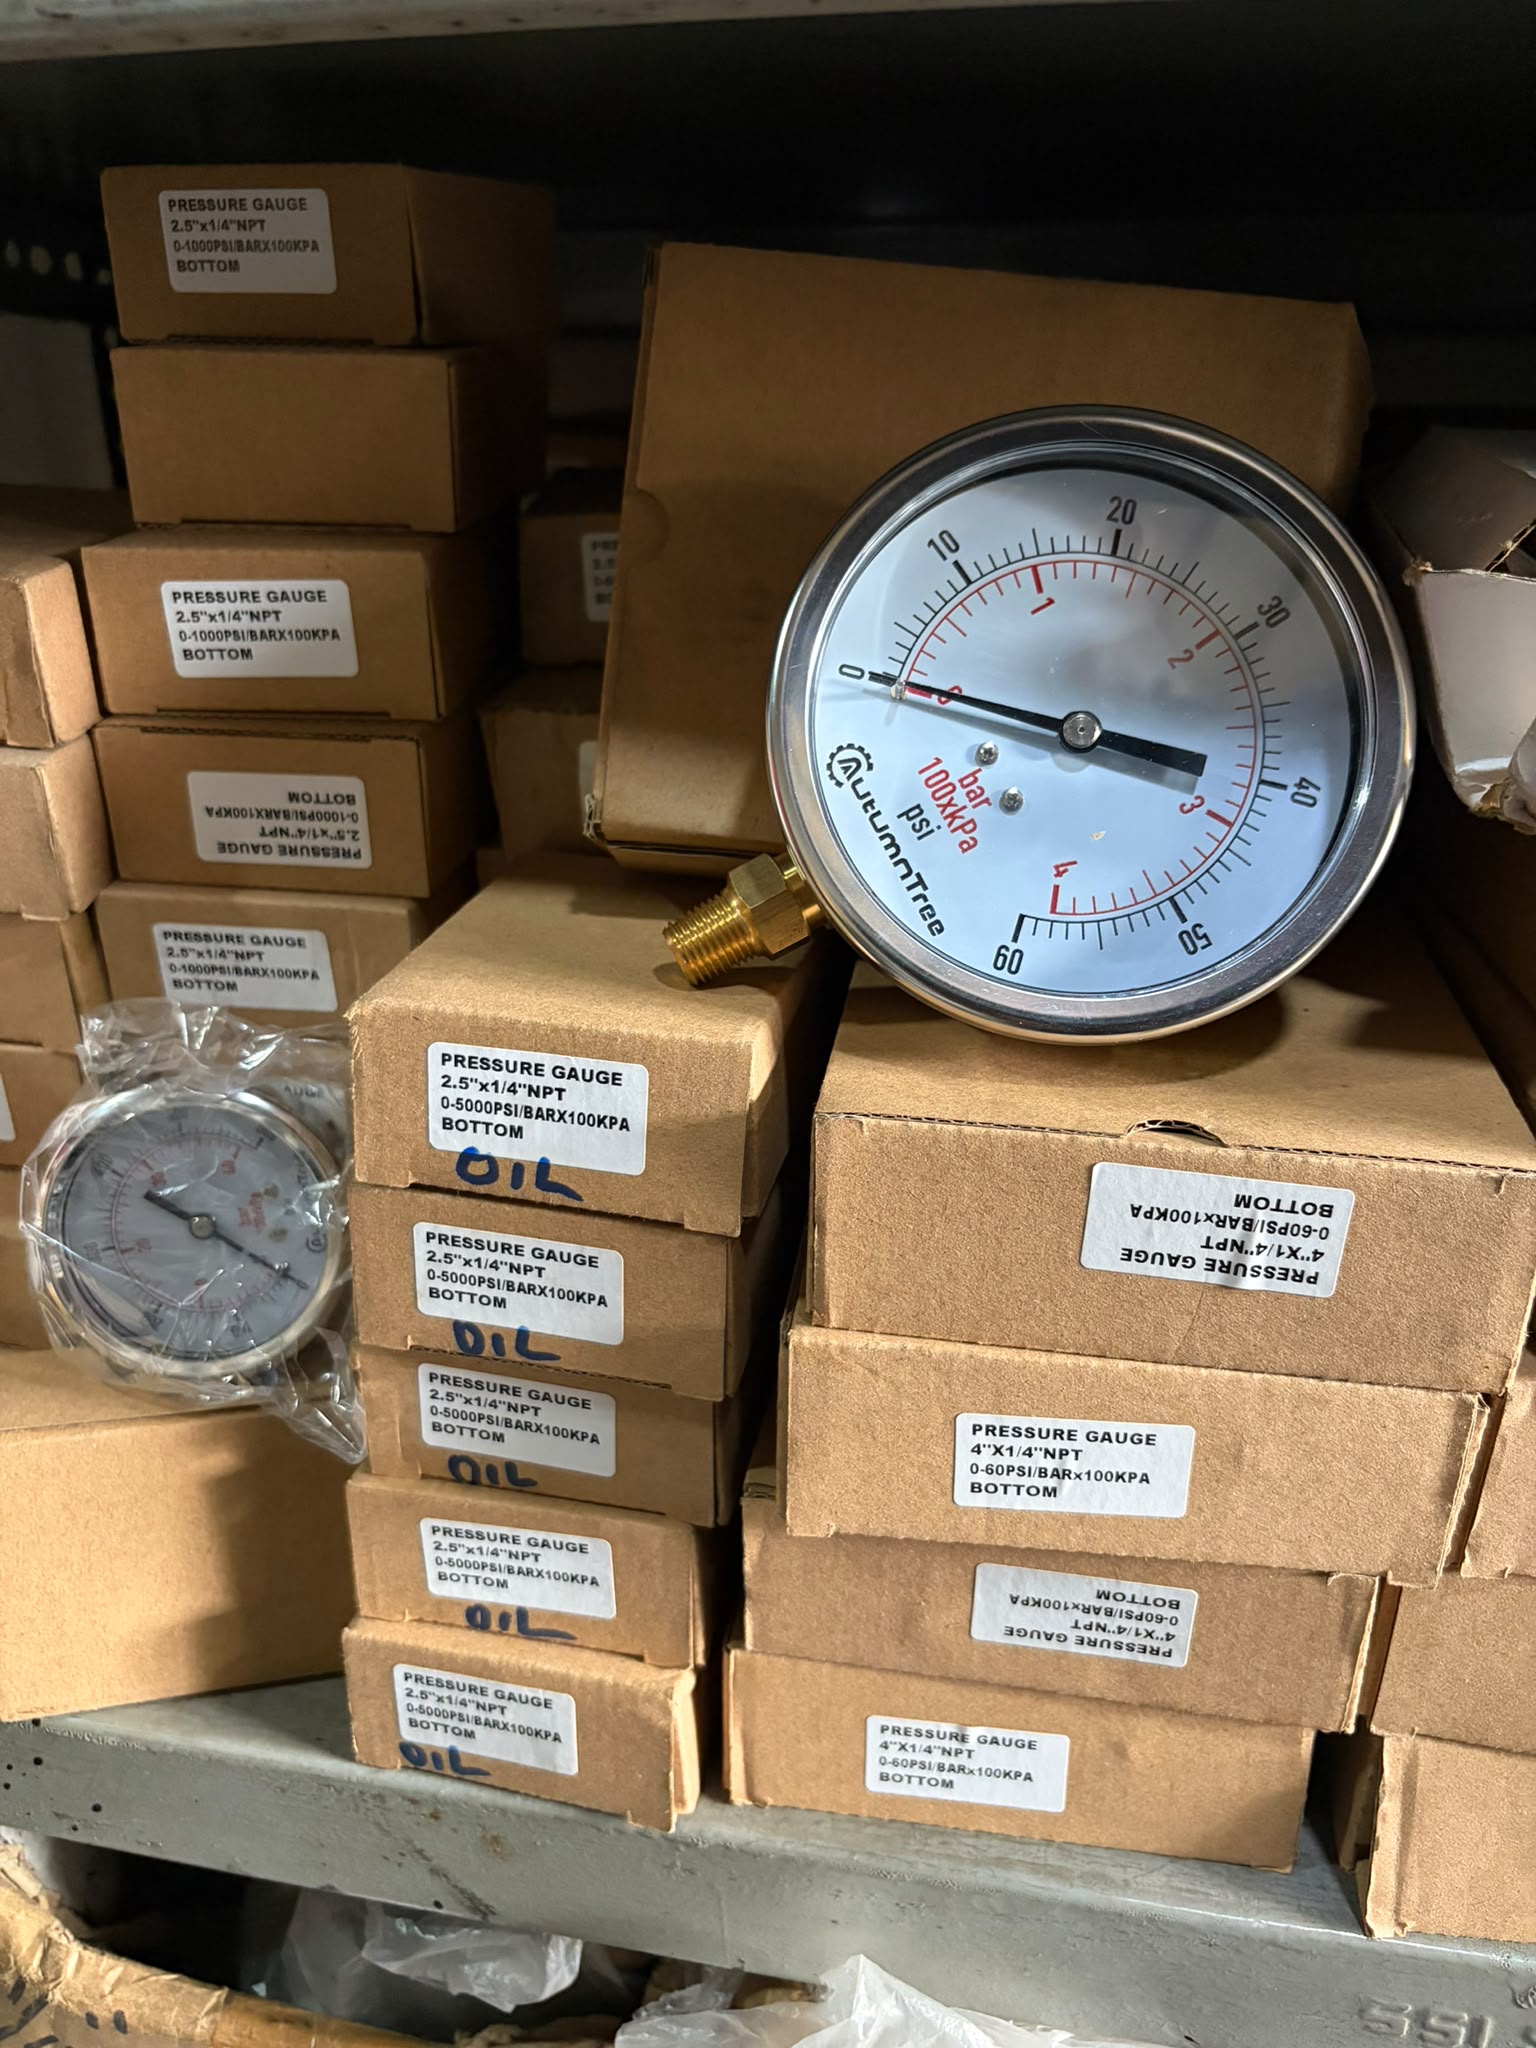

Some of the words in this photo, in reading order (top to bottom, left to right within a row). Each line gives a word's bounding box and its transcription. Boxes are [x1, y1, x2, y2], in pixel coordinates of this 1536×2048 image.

[168, 198, 248, 212] PRESSURE
[252, 197, 307, 211] GAUGE
[171, 219, 266, 232] 2.5"x1/4"NPT
[176, 260, 240, 272] BOTTOM
[1106, 495, 1137, 525] 20
[927, 528, 961, 561] 10
[172, 590, 261, 604] PRESSURE
[267, 590, 327, 603] GAUGE
[1031, 596, 1055, 616] 1
[176, 610, 282, 623] 2.5"x1/4"NPT
[1256, 595, 1292, 630] 30
[179, 629, 341, 642] 0-1000PSI/BARX100KPA
[183, 648, 253, 661] BOTTOM
[1167, 649, 1195, 670] 2
[838, 663, 865, 681] 0
[288, 791, 356, 805] BOTTOM
[957, 767, 993, 810] bar
[1290, 776, 1322, 809] 40
[917, 757, 979, 854] 100xkPa
[1179, 795, 1205, 815] 3
[896, 803, 942, 841] psi
[217, 841, 272, 855] GAUGE
[278, 844, 362, 859] PRESSURE
[836, 756, 945, 937] AutumnTree
[1052, 860, 1078, 878] 4
[163, 930, 245, 945] PRESSURE
[250, 935, 307, 949] GAUGE
[1177, 923, 1213, 955] 50
[993, 944, 1024, 975] 60
[173, 978, 238, 992] BOTTOM
[441, 1053, 545, 1077] PRESSURE
[552, 1065, 623, 1086] GAUGE
[441, 1074, 566, 1101] 2.5"x1/4"NPT
[441, 1096, 630, 1132] 0-5000PSI/BARX100KPA
[442, 1117, 524, 1139] BOTTOM
[455, 1146, 584, 1202] OIL
[1233, 1193, 1335, 1219] BOTTOM
[426, 1231, 525, 1257] PRESSURE
[531, 1247, 599, 1268] GAUGE
[1120, 1247, 1196, 1269] GAUGE
[426, 1250, 546, 1278] 2.5"x1/4"NPT
[1204, 1257, 1319, 1285] PRESSURE
[427, 1268, 608, 1307] 0-5000PSI/BARX100KPA
[428, 1286, 507, 1309] BOTTOM
[453, 1319, 561, 1362] OIL
[429, 1372, 522, 1397] PRESSURE
[528, 1389, 592, 1410] GAUGE
[429, 1388, 542, 1417] 2.5"x1/4"NPT
[430, 1405, 600, 1445] 0-5000PSI/BARX100KPA
[432, 1421, 505, 1443] BOTTOM
[971, 1423, 1078, 1442] PRESSURE
[1085, 1430, 1157, 1446] GAUGE
[970, 1443, 1083, 1461] 4"X1/4"NPT
[448, 1454, 538, 1487] OIL
[970, 1481, 1057, 1498] BOTTOM
[431, 1525, 521, 1545] PRESSURE
[527, 1536, 589, 1554] GAUGE
[433, 1540, 541, 1563] 2.5"x1/4"NPT
[435, 1556, 599, 1587] 0-5000PSI/BARX100KPA
[438, 1571, 509, 1589] BOTTOM
[1096, 1589, 1181, 1610] BOTTOM
[465, 1603, 577, 1641] OIL
[1003, 1625, 1068, 1643] GAUGE
[1075, 1635, 1173, 1658] PRESSURE
[404, 1672, 489, 1697] PRESSURE
[494, 1689, 553, 1709] GAUGE
[405, 1687, 507, 1716] 2.5"x1/4"NPT
[406, 1702, 562, 1744] 0-5000PSI/BARX100KPA
[408, 1717, 476, 1740] BOTTOM
[880, 1724, 970, 1743] PRESSURE
[976, 1734, 1038, 1750] GAUGE
[398, 1741, 492, 1777] OIL
[879, 1740, 975, 1759] 4"X1/4"NPT
[879, 1772, 954, 1789] BOTTOM
